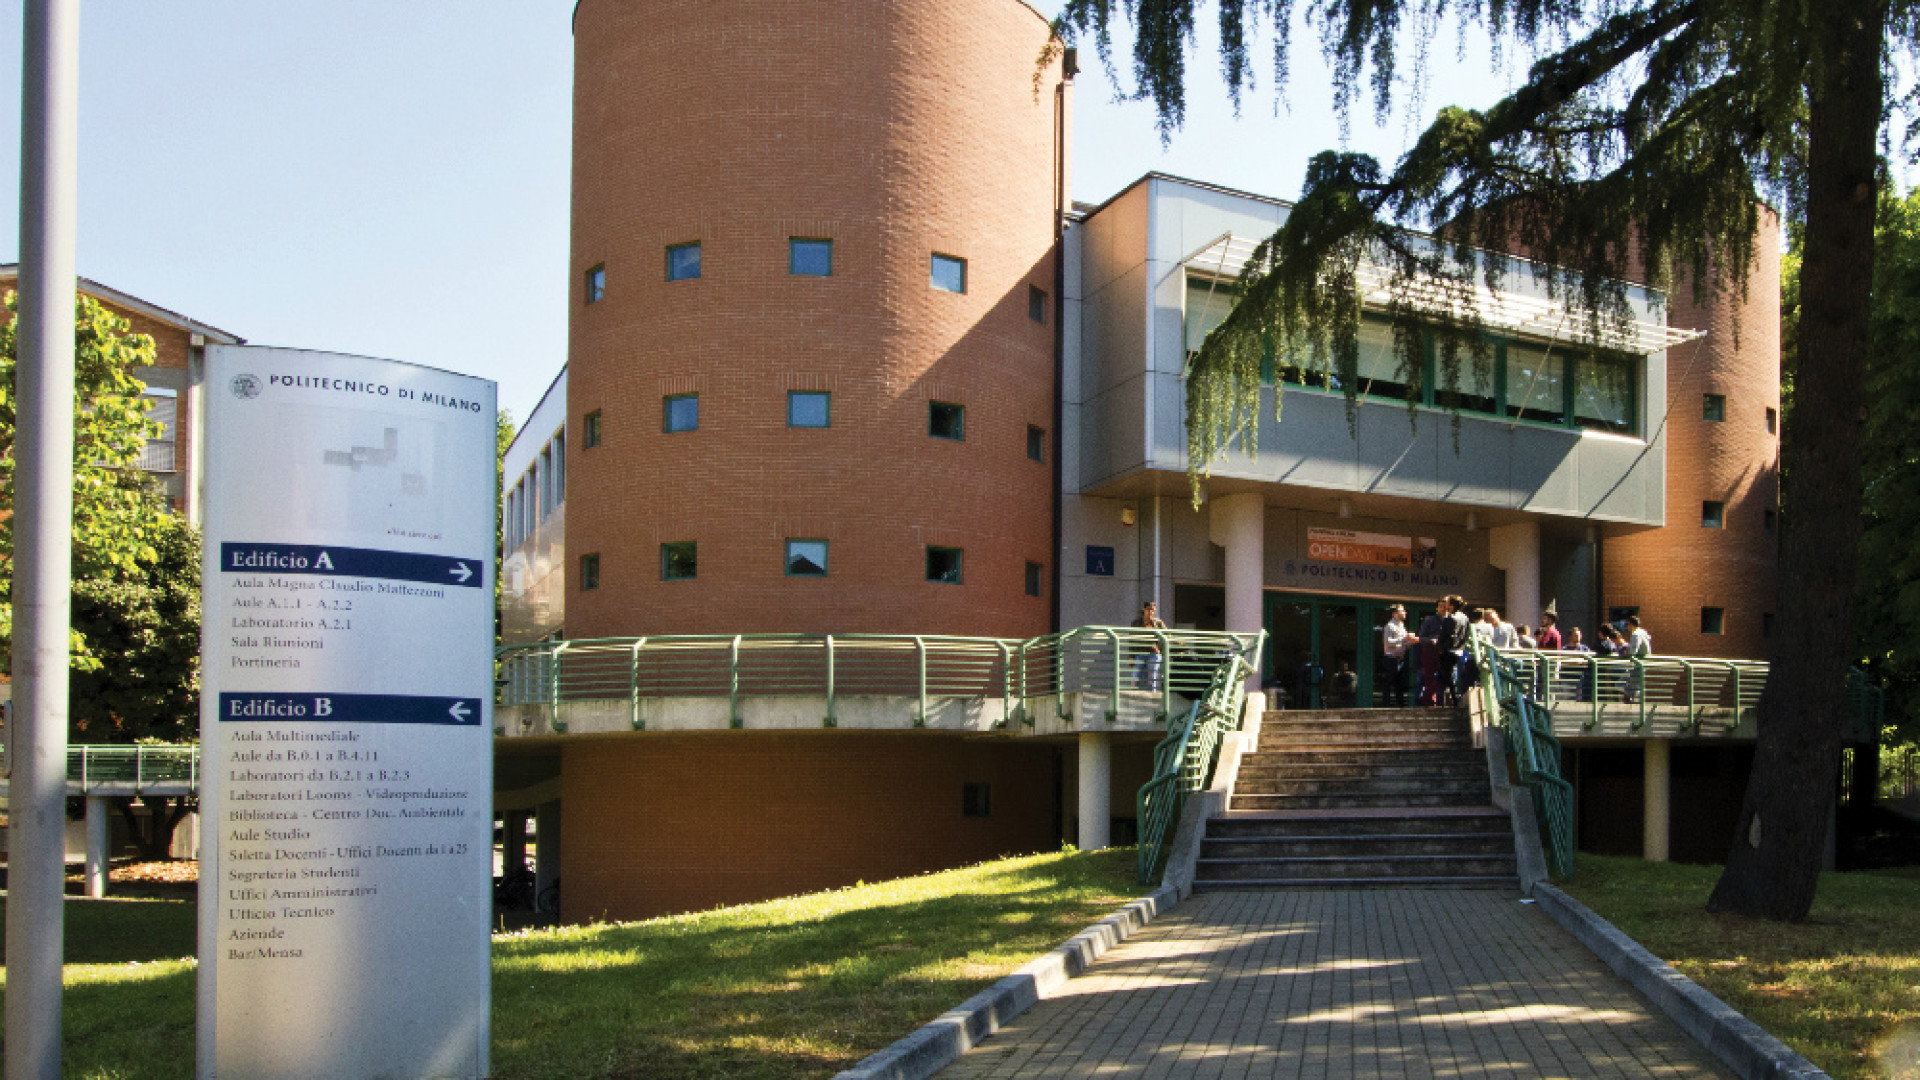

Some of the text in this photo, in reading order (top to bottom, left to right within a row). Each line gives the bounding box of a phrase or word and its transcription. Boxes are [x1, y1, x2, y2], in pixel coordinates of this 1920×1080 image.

[269, 374, 482, 413] POLITECNICO DI MILANO
[231, 550, 335, 571] Edificio A
[1302, 564, 1459, 587] POLITECNICO DI MILANO
[231, 577, 264, 589] Aula
[268, 577, 316, 592] Magna
[318, 579, 374, 593] Claudio
[231, 596, 263, 609] Aule
[266, 597, 301, 609] A.1.1
[316, 598, 353, 611] A.2.2
[231, 616, 352, 630] Laboratorio A.2.1
[231, 635, 324, 650] Sala Riunioni
[231, 655, 301, 669] Portineria
[229, 697, 333, 717] Edificio B
[231, 729, 360, 742] Aula Multimediale
[230, 750, 379, 762] Aule da B.0.1 a B.4.11
[229, 769, 304, 781] Laboratori
[306, 769, 324, 781] da
[329, 769, 362, 781] B.2.1
[366, 772, 374, 781] a
[229, 789, 302, 801] Laboratori
[229, 808, 299, 821] Biblioteca
[312, 808, 362, 820] Centro
[229, 828, 311, 841] Aule Studio
[229, 849, 272, 862] Saletta
[275, 847, 327, 861] Docenti
[337, 845, 372, 859] Uffici
[456, 843, 468, 855] 25
[229, 866, 360, 883] Segreteria Studenti
[229, 884, 378, 900] Uffici Amministrativi
[229, 906, 335, 920] Ufficio Tecnico
[228, 927, 285, 941] Aziende
[228, 947, 303, 960] Bar/Mensa
